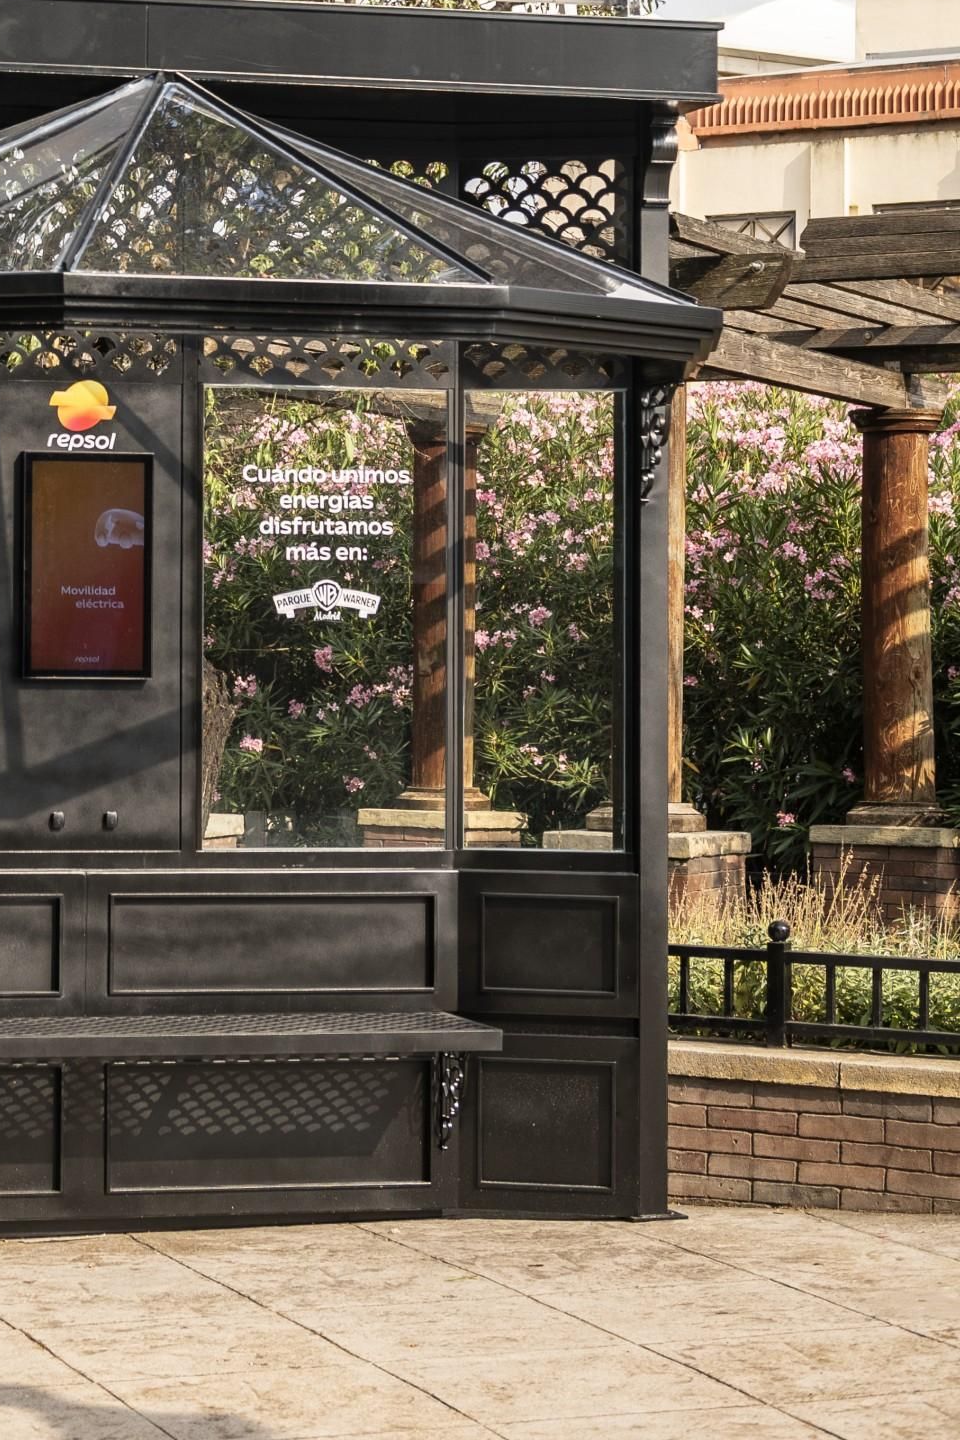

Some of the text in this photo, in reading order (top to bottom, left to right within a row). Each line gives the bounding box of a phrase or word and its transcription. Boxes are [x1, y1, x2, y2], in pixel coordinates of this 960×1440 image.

[47, 432, 116, 451] repsol
[332, 465, 410, 484] unimos
[279, 491, 374, 513] energías
[259, 516, 394, 535] disfrutamos
[286, 542, 368, 560] más en:
[61, 585, 116, 595] Movilidad
[276, 583, 377, 609] PARQUE WB WARNER
[75, 599, 125, 609] eléctrica
[313, 610, 342, 621] Madrid
